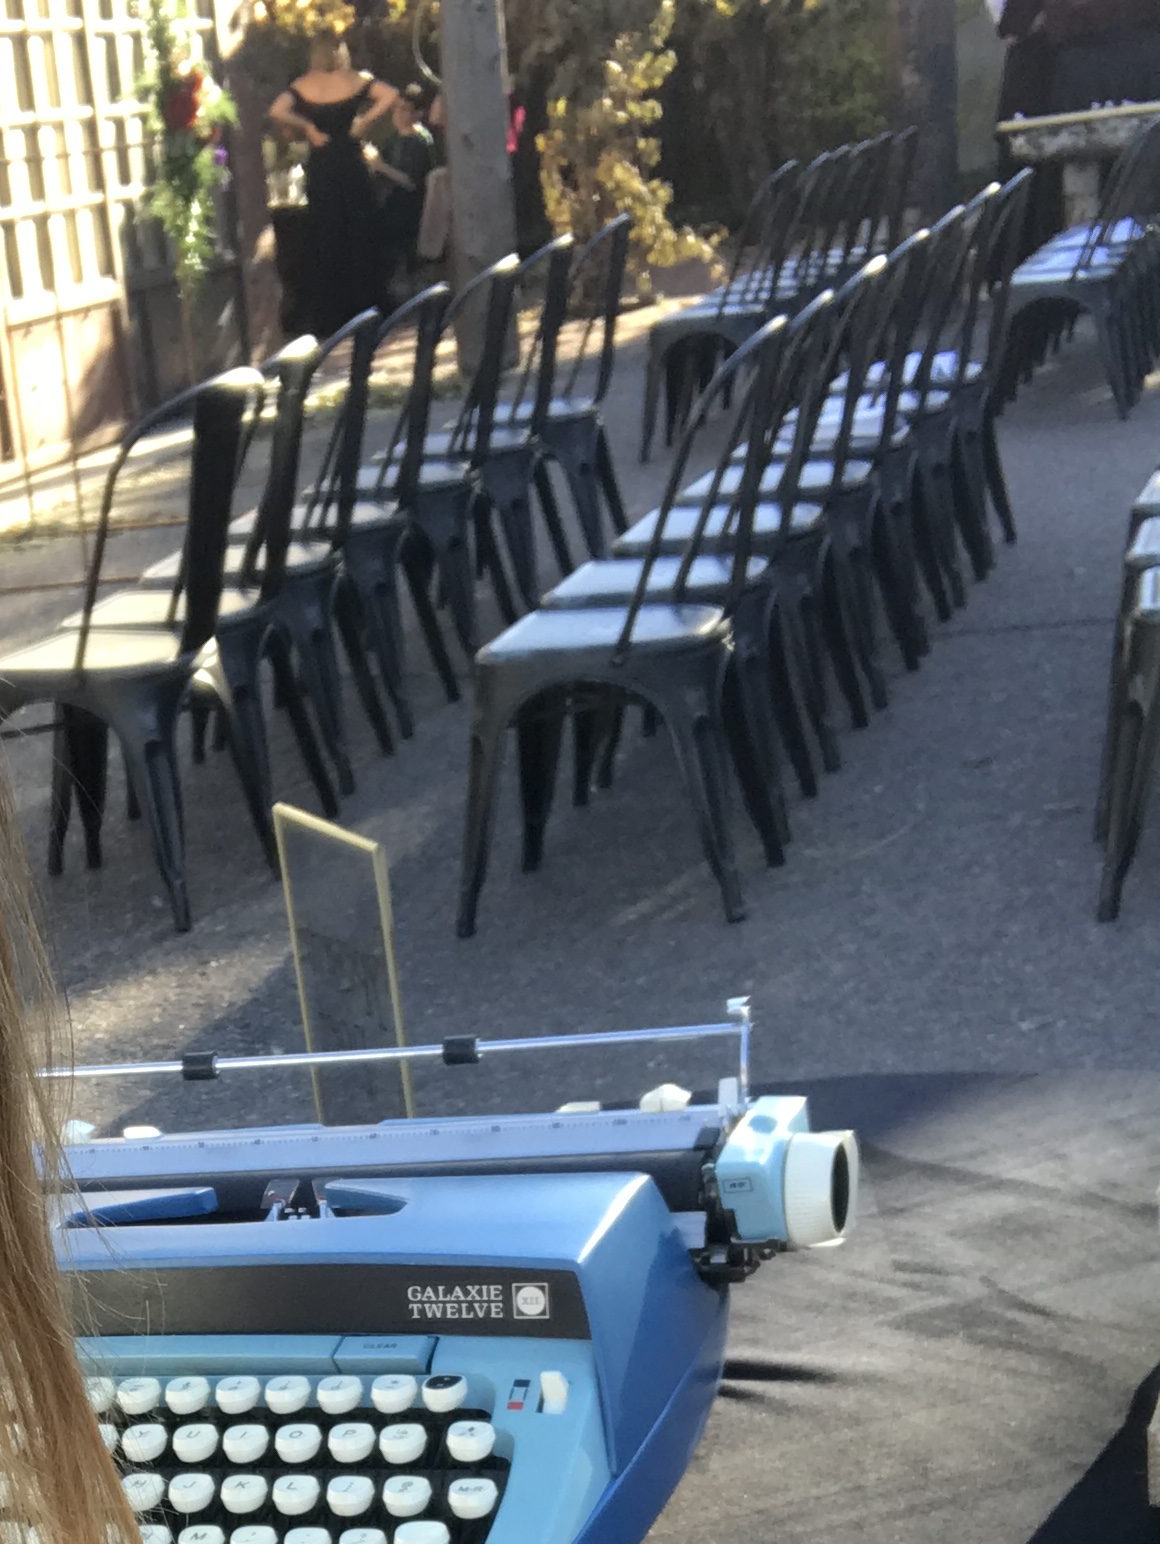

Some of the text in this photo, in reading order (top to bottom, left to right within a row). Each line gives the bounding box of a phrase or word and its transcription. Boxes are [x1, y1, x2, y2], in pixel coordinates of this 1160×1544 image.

[407, 1285, 503, 1301] GALAXIE
[408, 1302, 504, 1319] TWELVE
[185, 1430, 201, 1439] U
